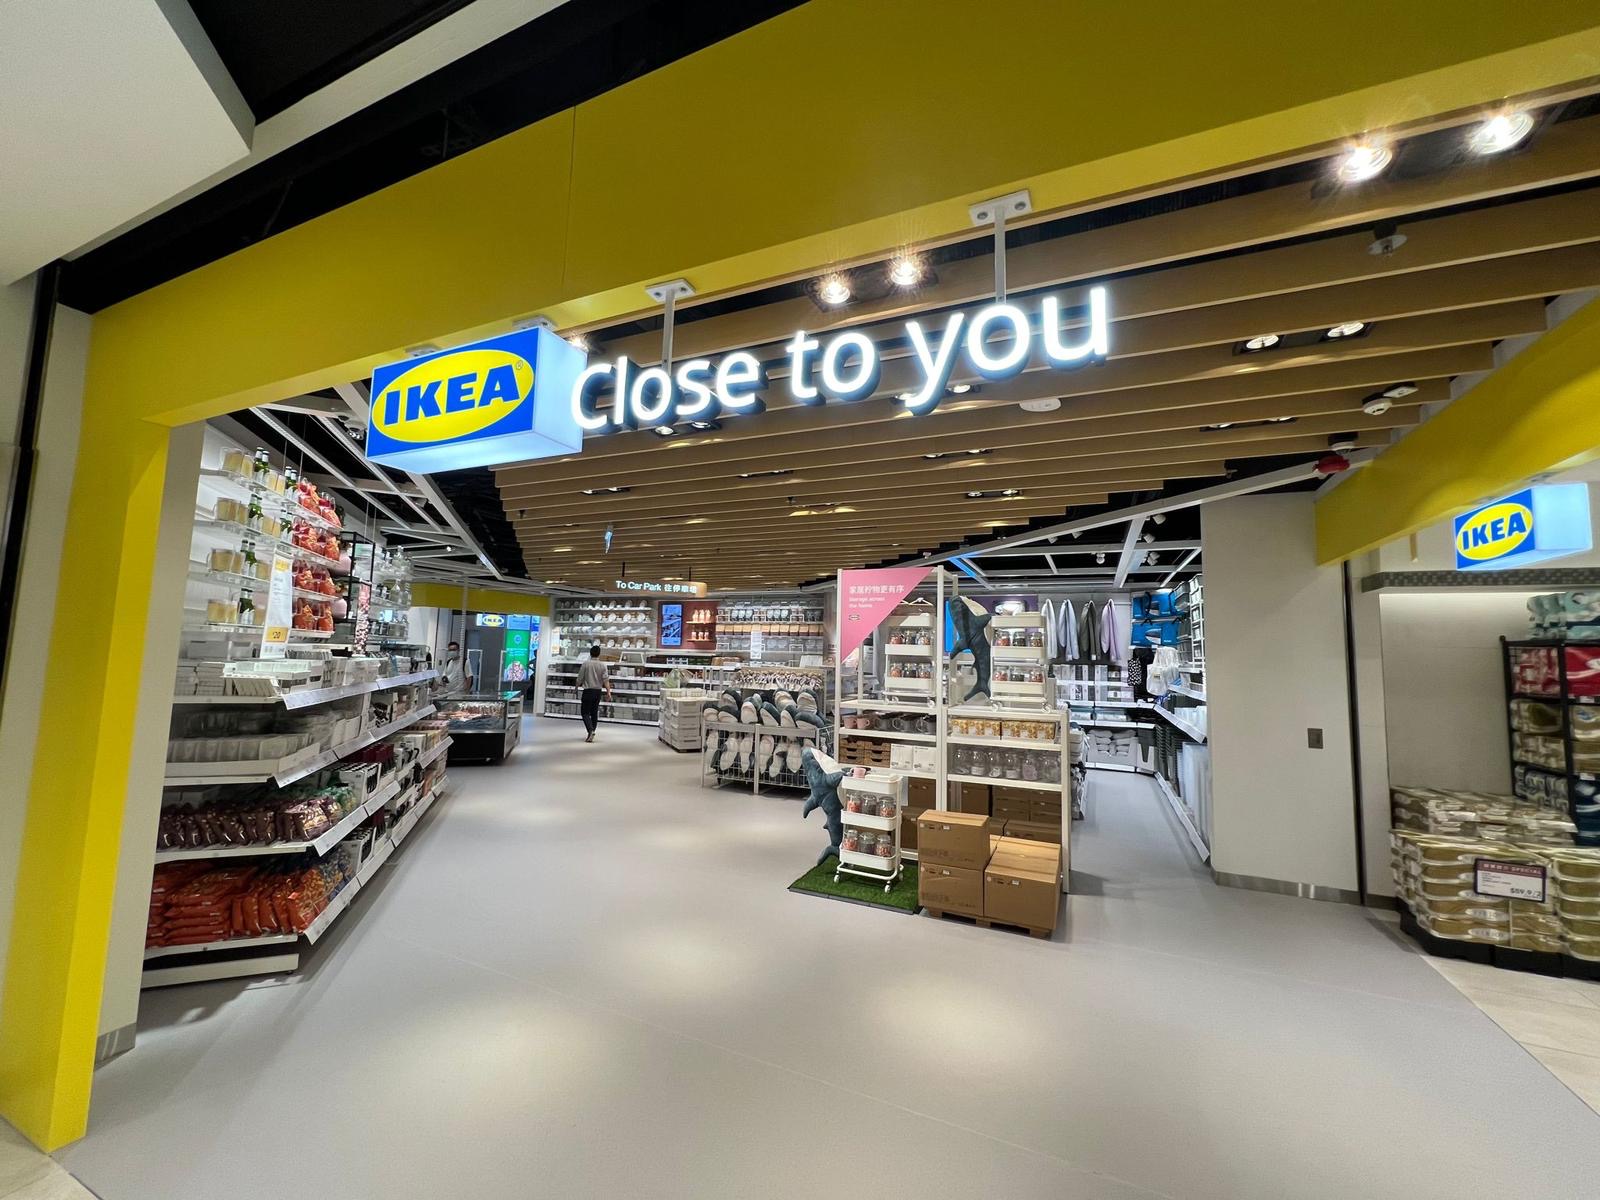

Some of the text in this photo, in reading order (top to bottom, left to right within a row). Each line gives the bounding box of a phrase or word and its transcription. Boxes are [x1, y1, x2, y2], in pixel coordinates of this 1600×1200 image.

[571, 287, 1109, 430] Close to you
[1462, 511, 1527, 550] IKEA
[616, 580, 627, 589] To
[628, 581, 643, 590] Car
[643, 582, 662, 591] Park
